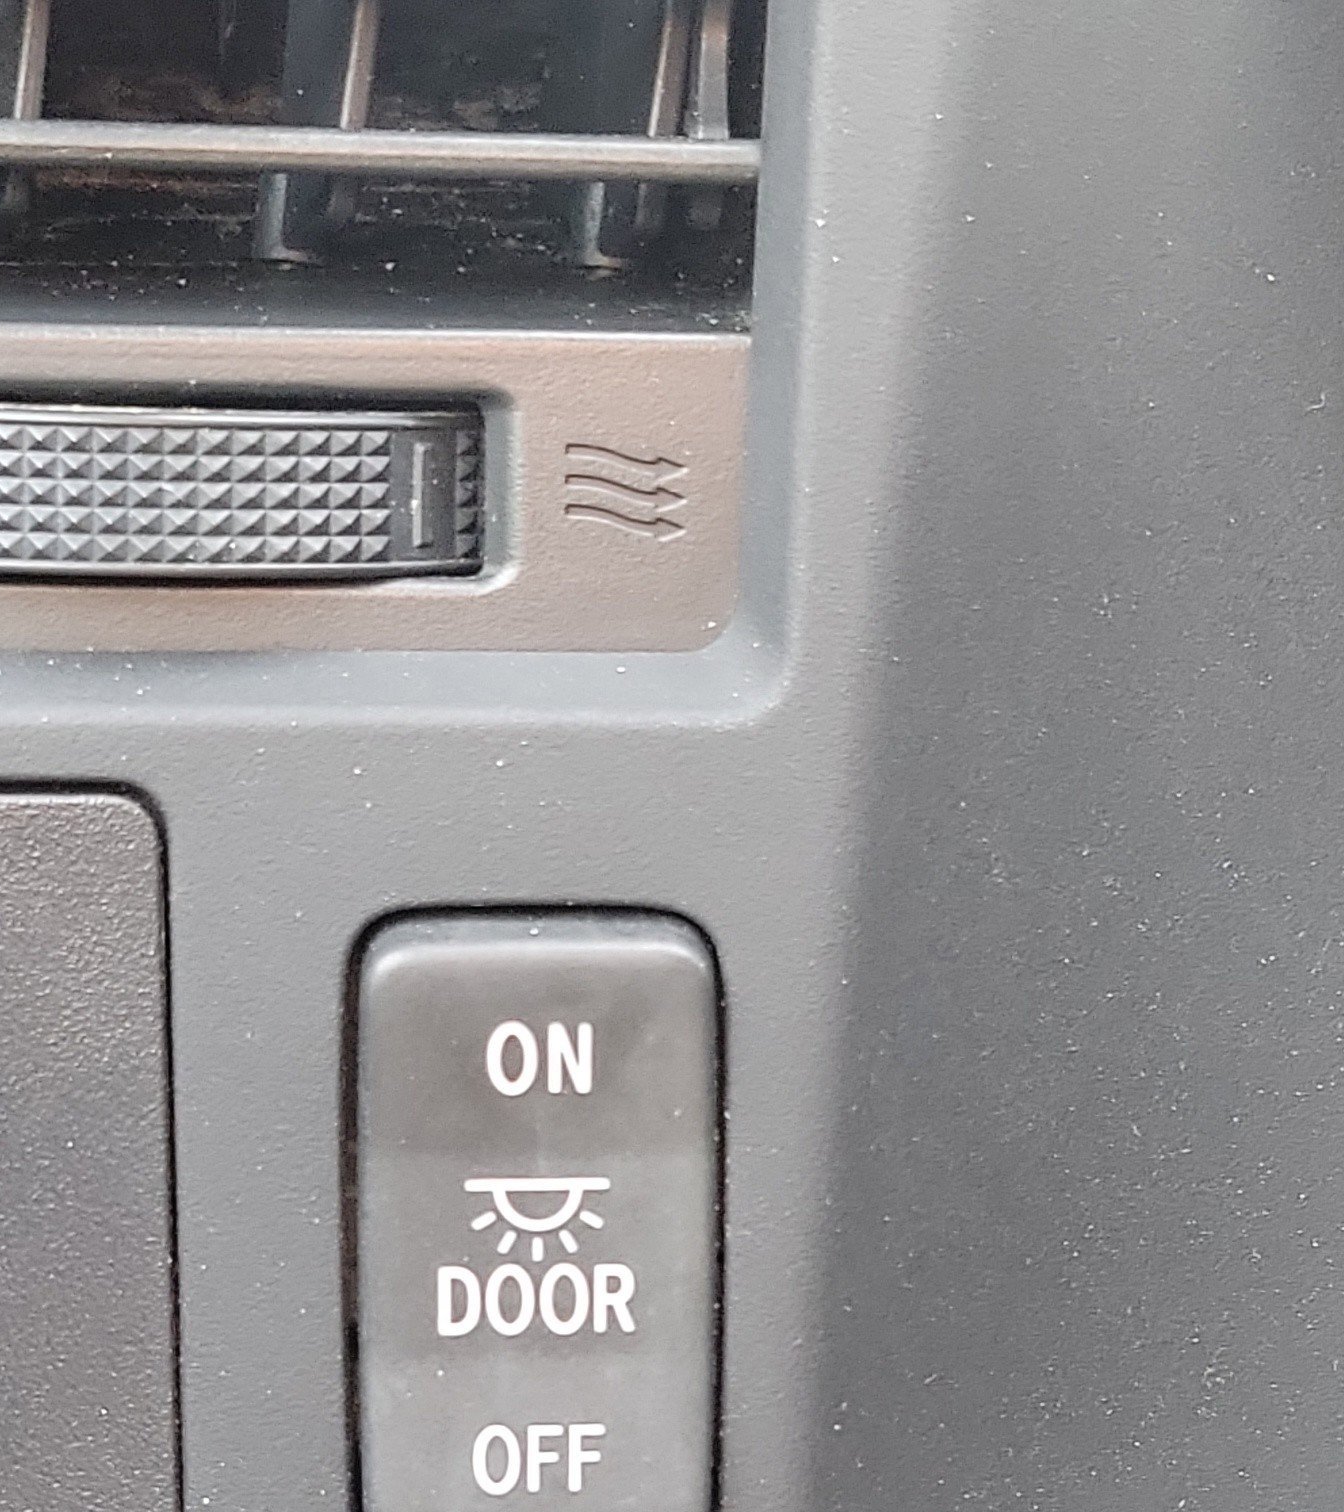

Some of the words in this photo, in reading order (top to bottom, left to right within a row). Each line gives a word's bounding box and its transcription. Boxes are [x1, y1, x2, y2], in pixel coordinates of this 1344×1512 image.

[486, 1020, 593, 1095] ON
[436, 1263, 636, 1336] DOOR
[472, 1423, 606, 1495] OFF
